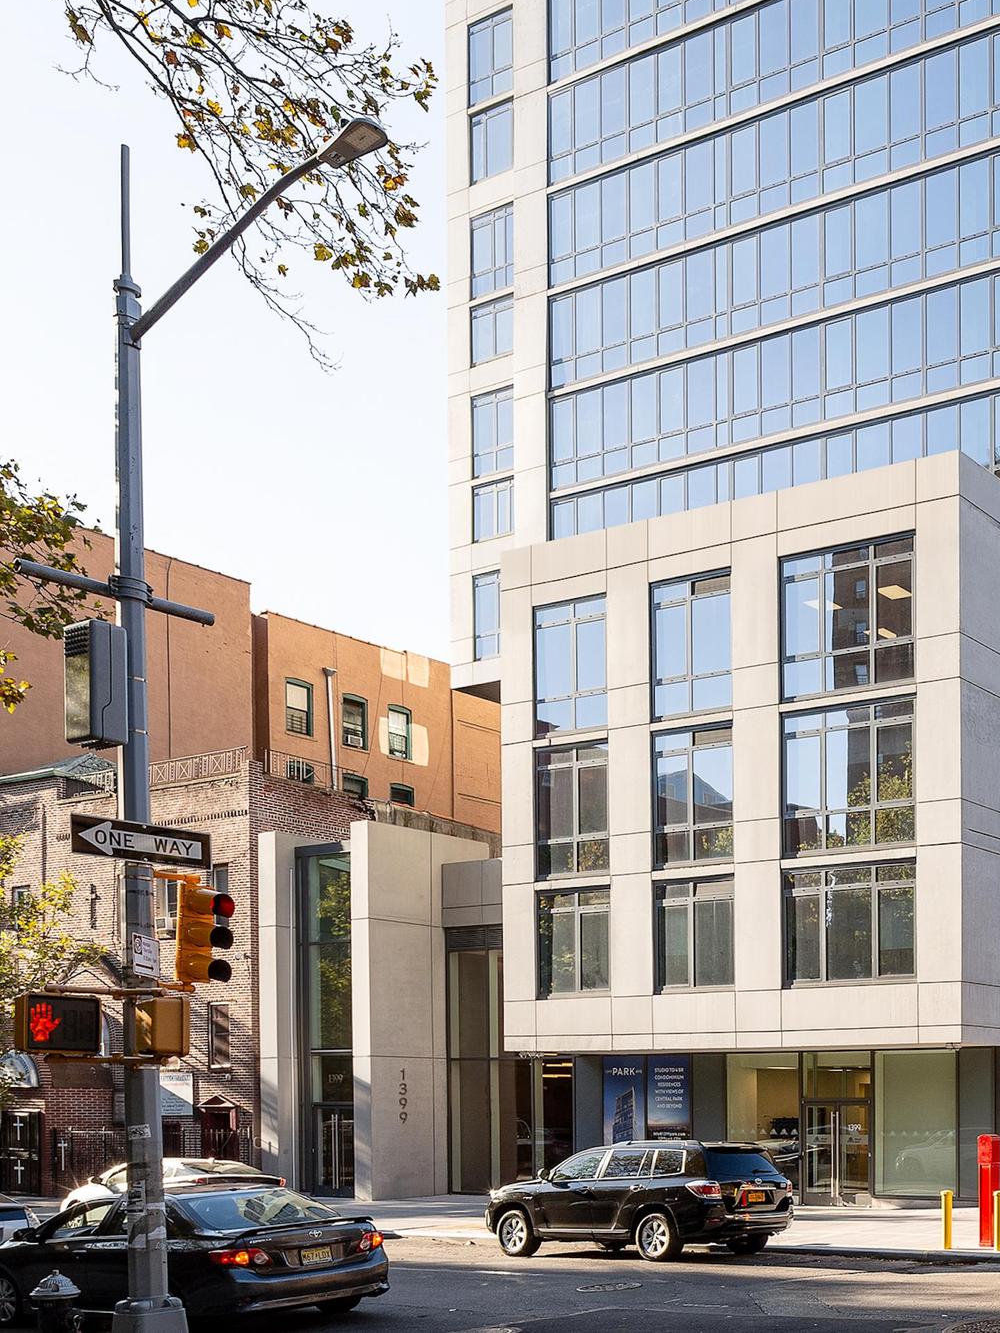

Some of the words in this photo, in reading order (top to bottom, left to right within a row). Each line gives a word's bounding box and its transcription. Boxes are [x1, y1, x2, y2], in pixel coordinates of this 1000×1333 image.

[95, 829, 135, 849] ONE
[154, 837, 193, 856] WAY
[612, 1067, 636, 1076] PARK
[399, 1068, 408, 1124] 1399
[848, 1123, 861, 1131] 1399
